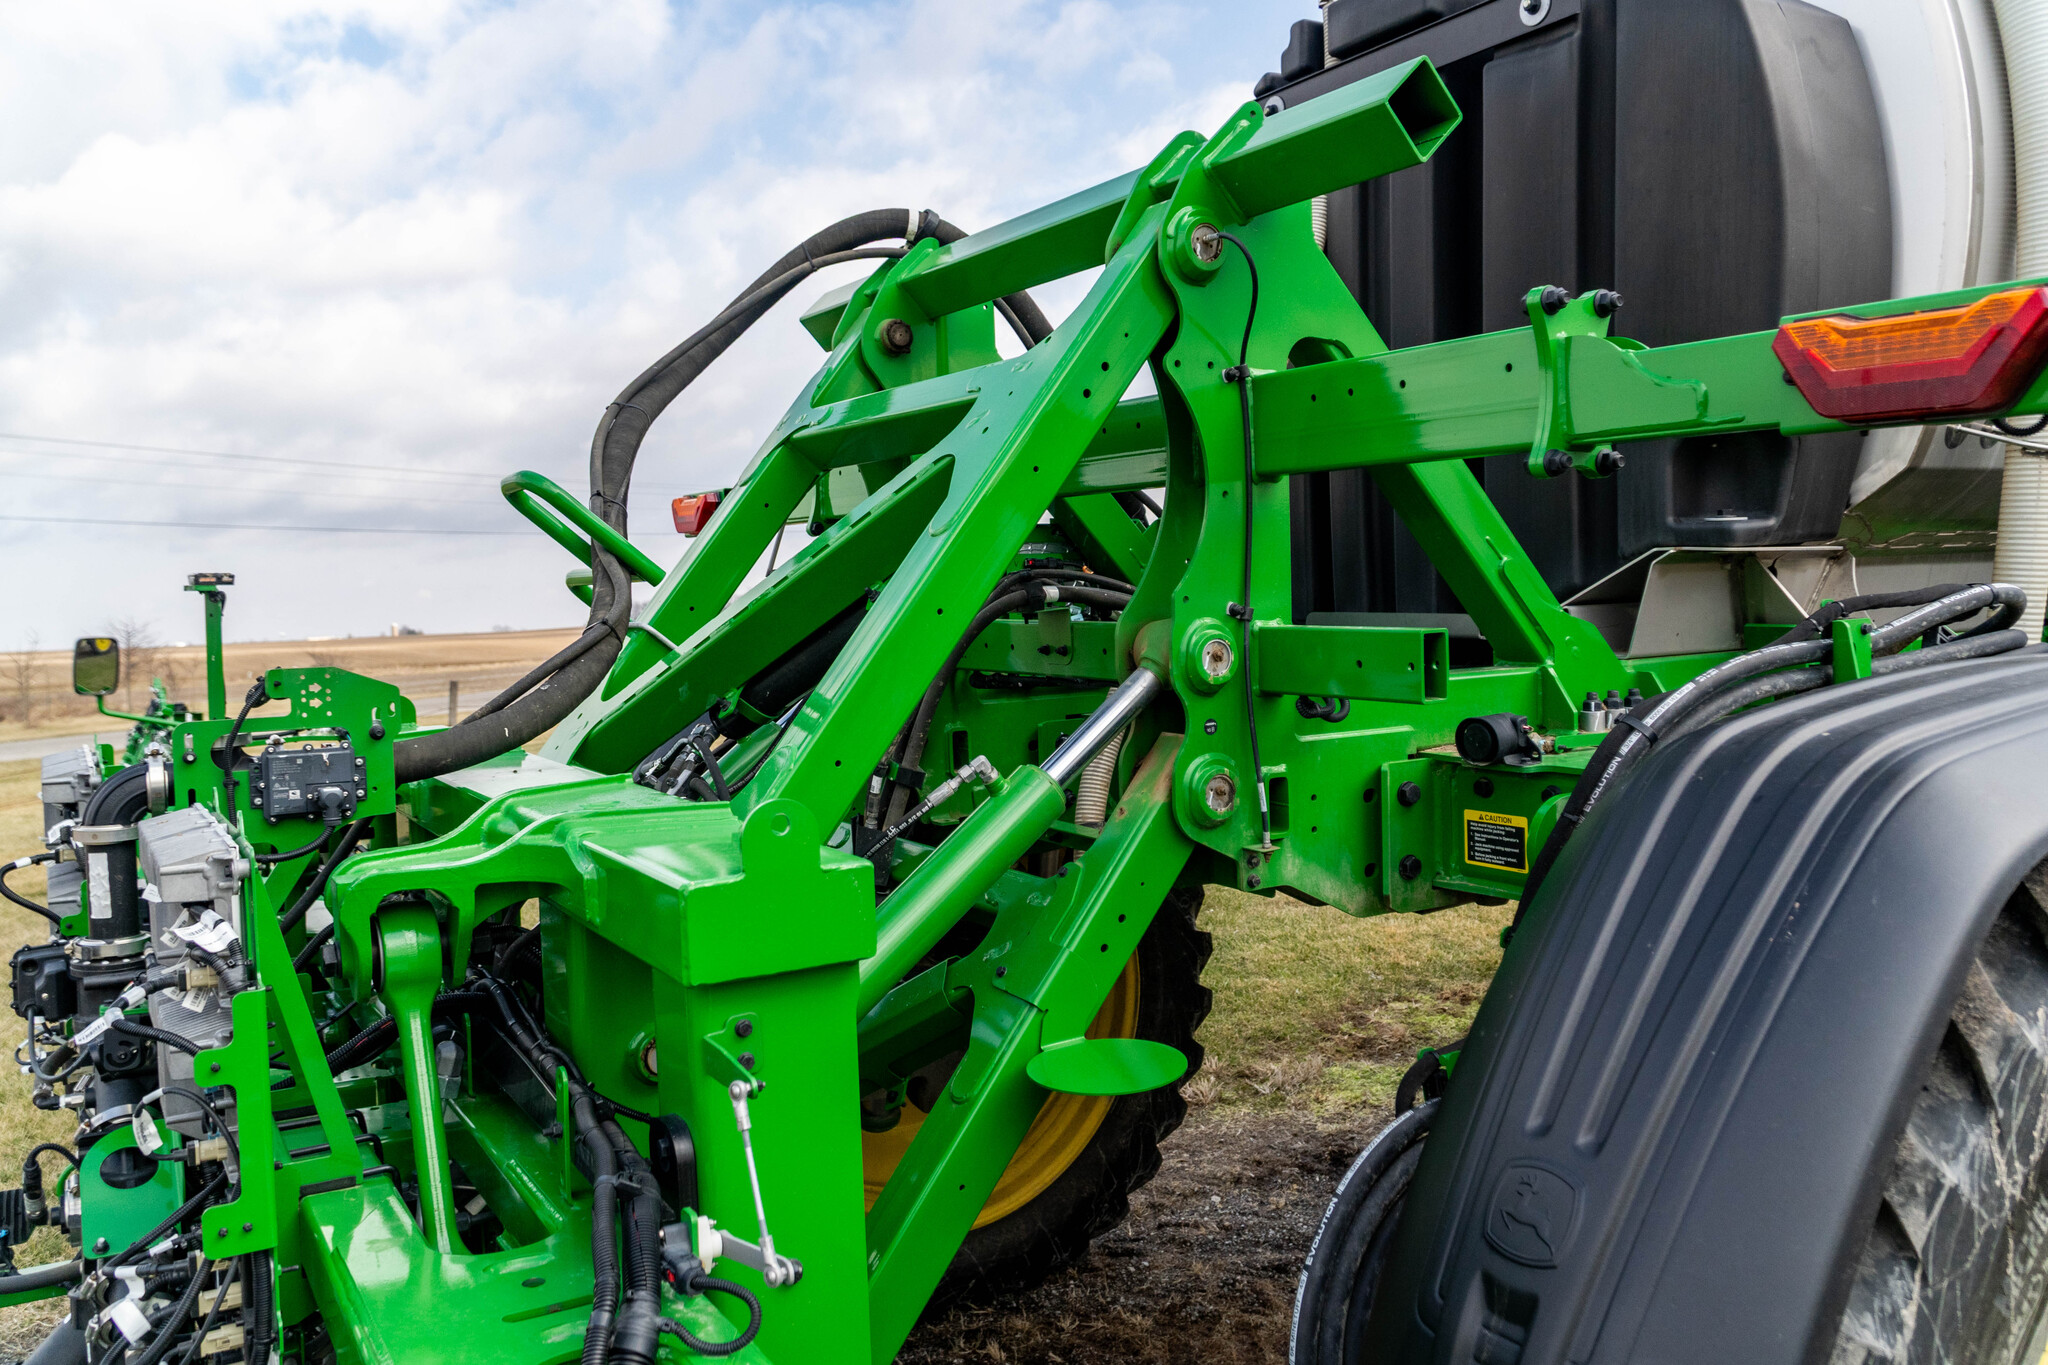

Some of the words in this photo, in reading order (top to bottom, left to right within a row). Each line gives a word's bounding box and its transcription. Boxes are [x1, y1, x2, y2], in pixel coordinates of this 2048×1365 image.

[1944, 587, 1984, 604] EVOLUTION
[1584, 756, 1622, 813] EVOLUTION
[1485, 815, 1512, 824] CAUTION
[1305, 1197, 1338, 1266] EVOLUTION
